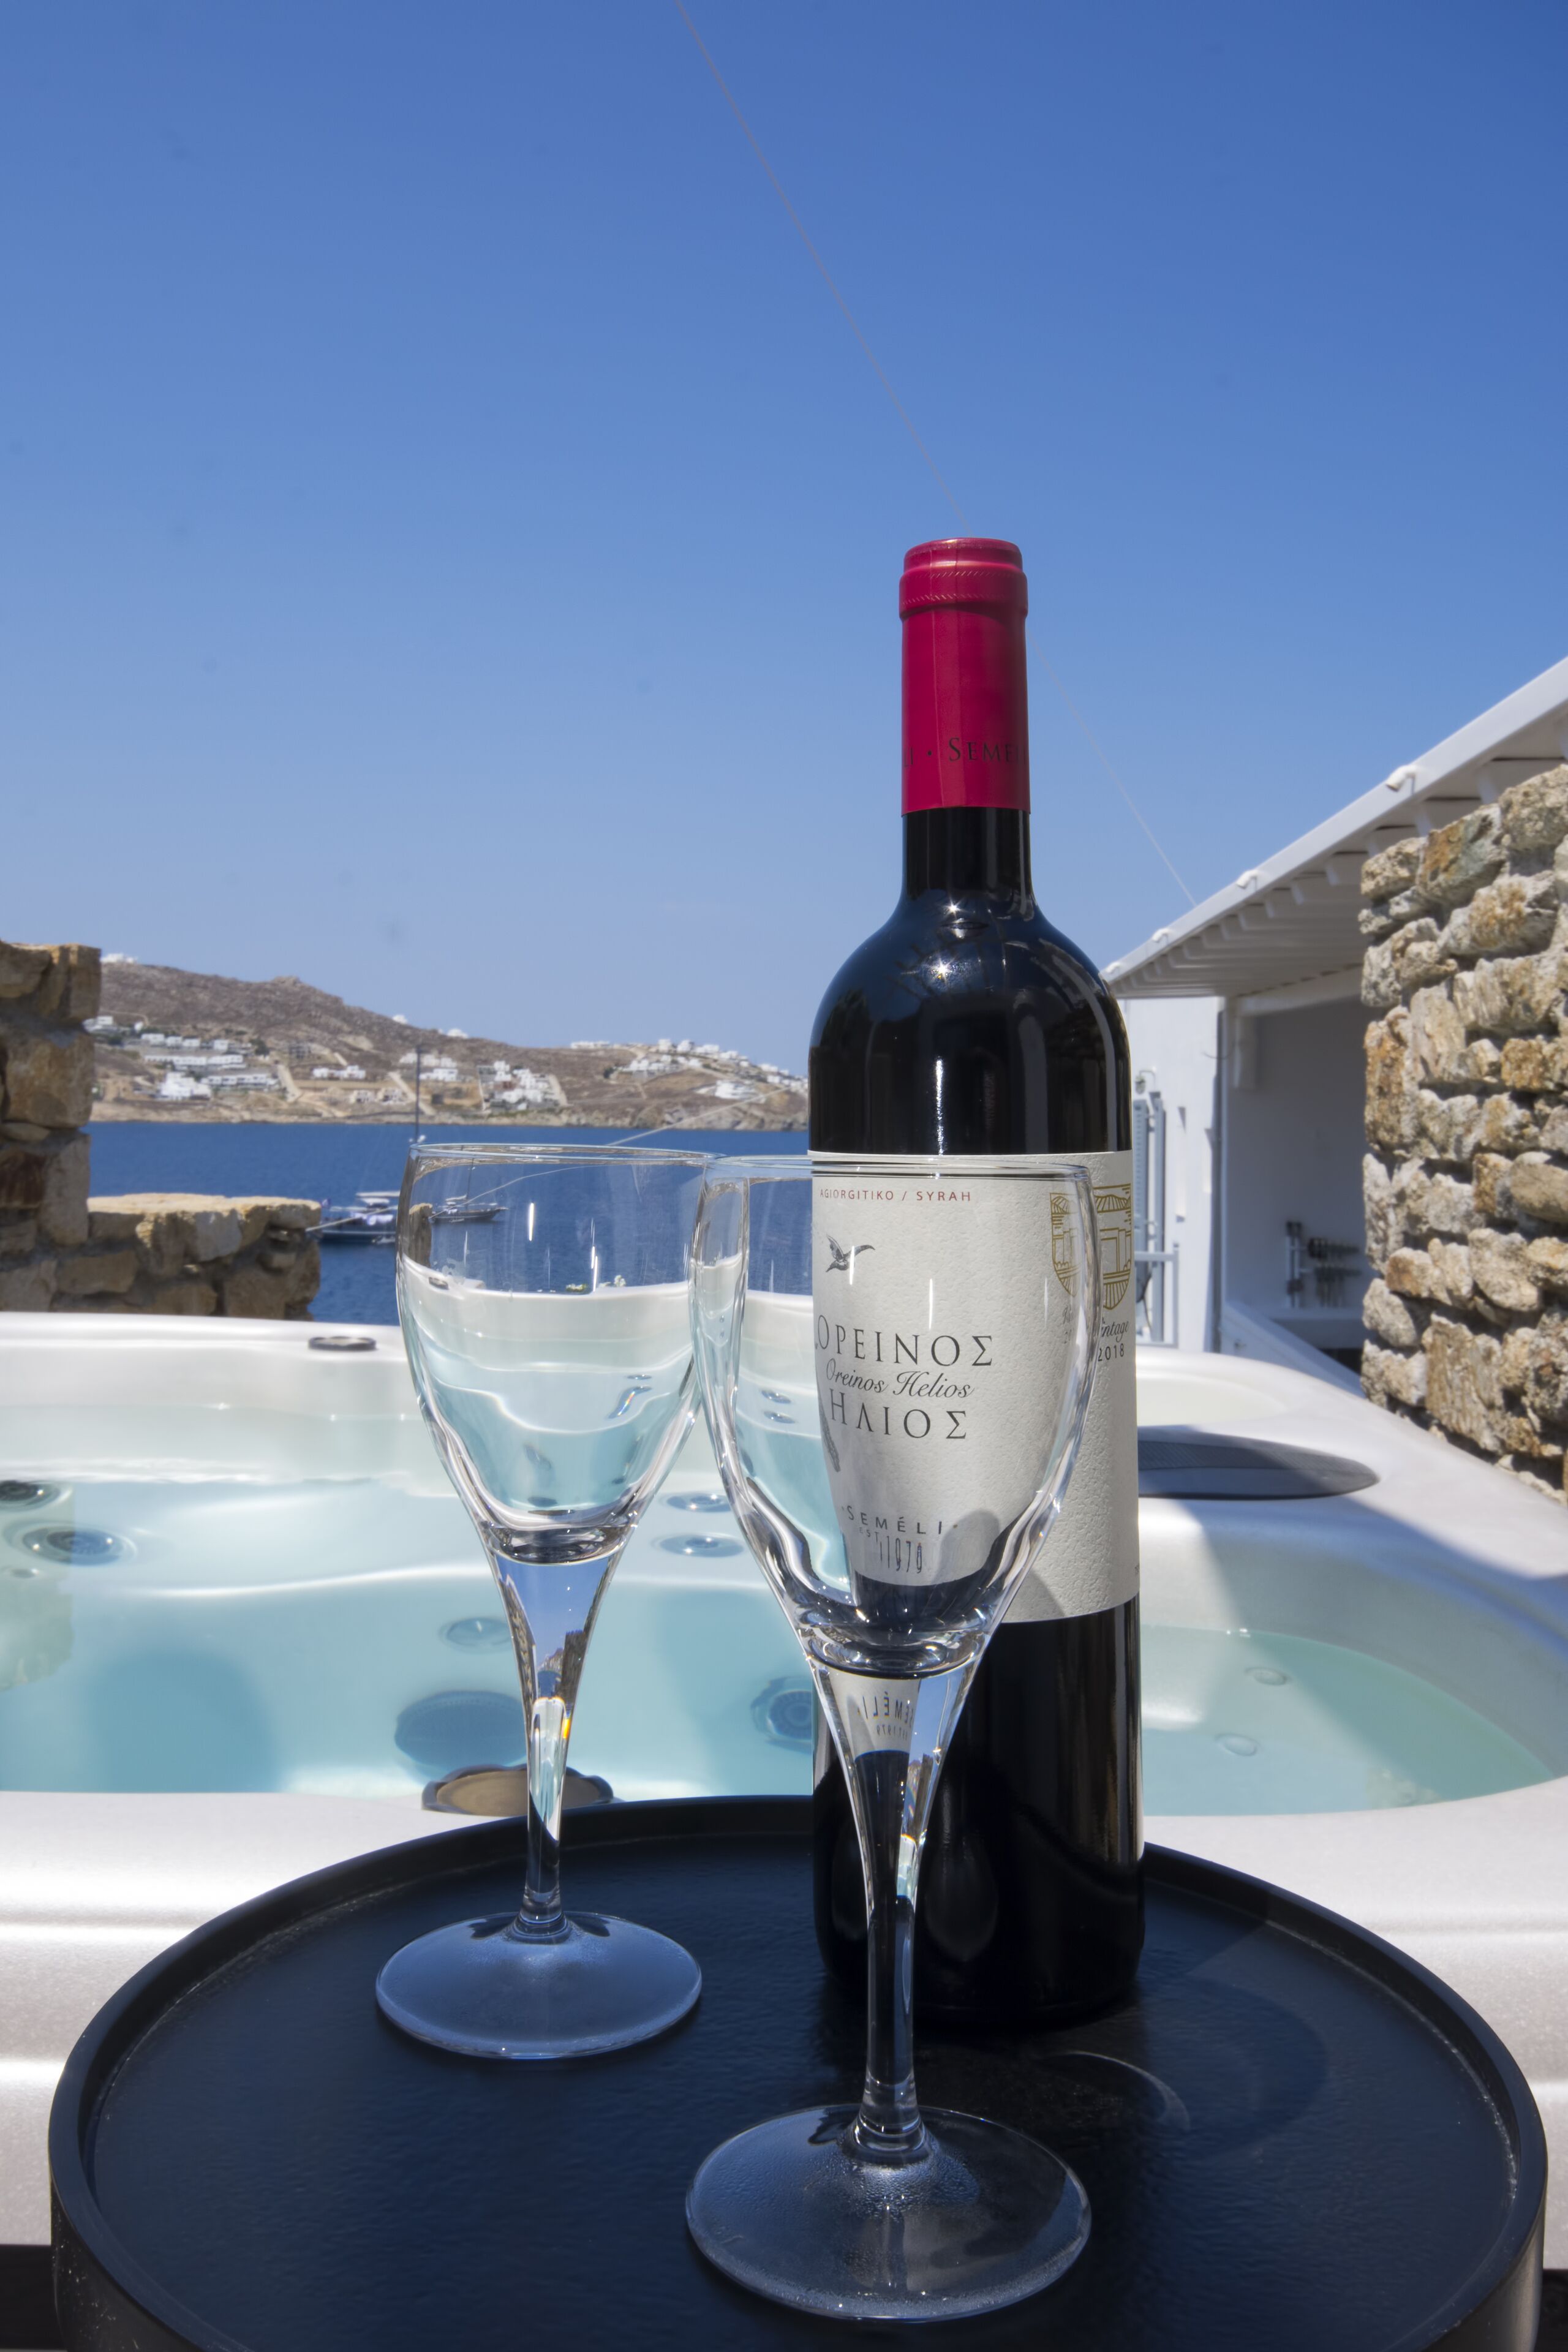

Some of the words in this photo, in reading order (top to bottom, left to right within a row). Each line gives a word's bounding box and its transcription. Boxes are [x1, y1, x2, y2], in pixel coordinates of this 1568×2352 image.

[820, 1189, 894, 1200] AGIORGITIKO
[916, 1191, 971, 1201] SYRAH
[1098, 1343, 1125, 1362] 2018
[826, 1358, 888, 1393] Oreinos
[892, 1371, 975, 1398] Helios
[829, 1388, 967, 1439] ΗΛΙΟΣ
[847, 1506, 942, 1535] SEMÉLI
